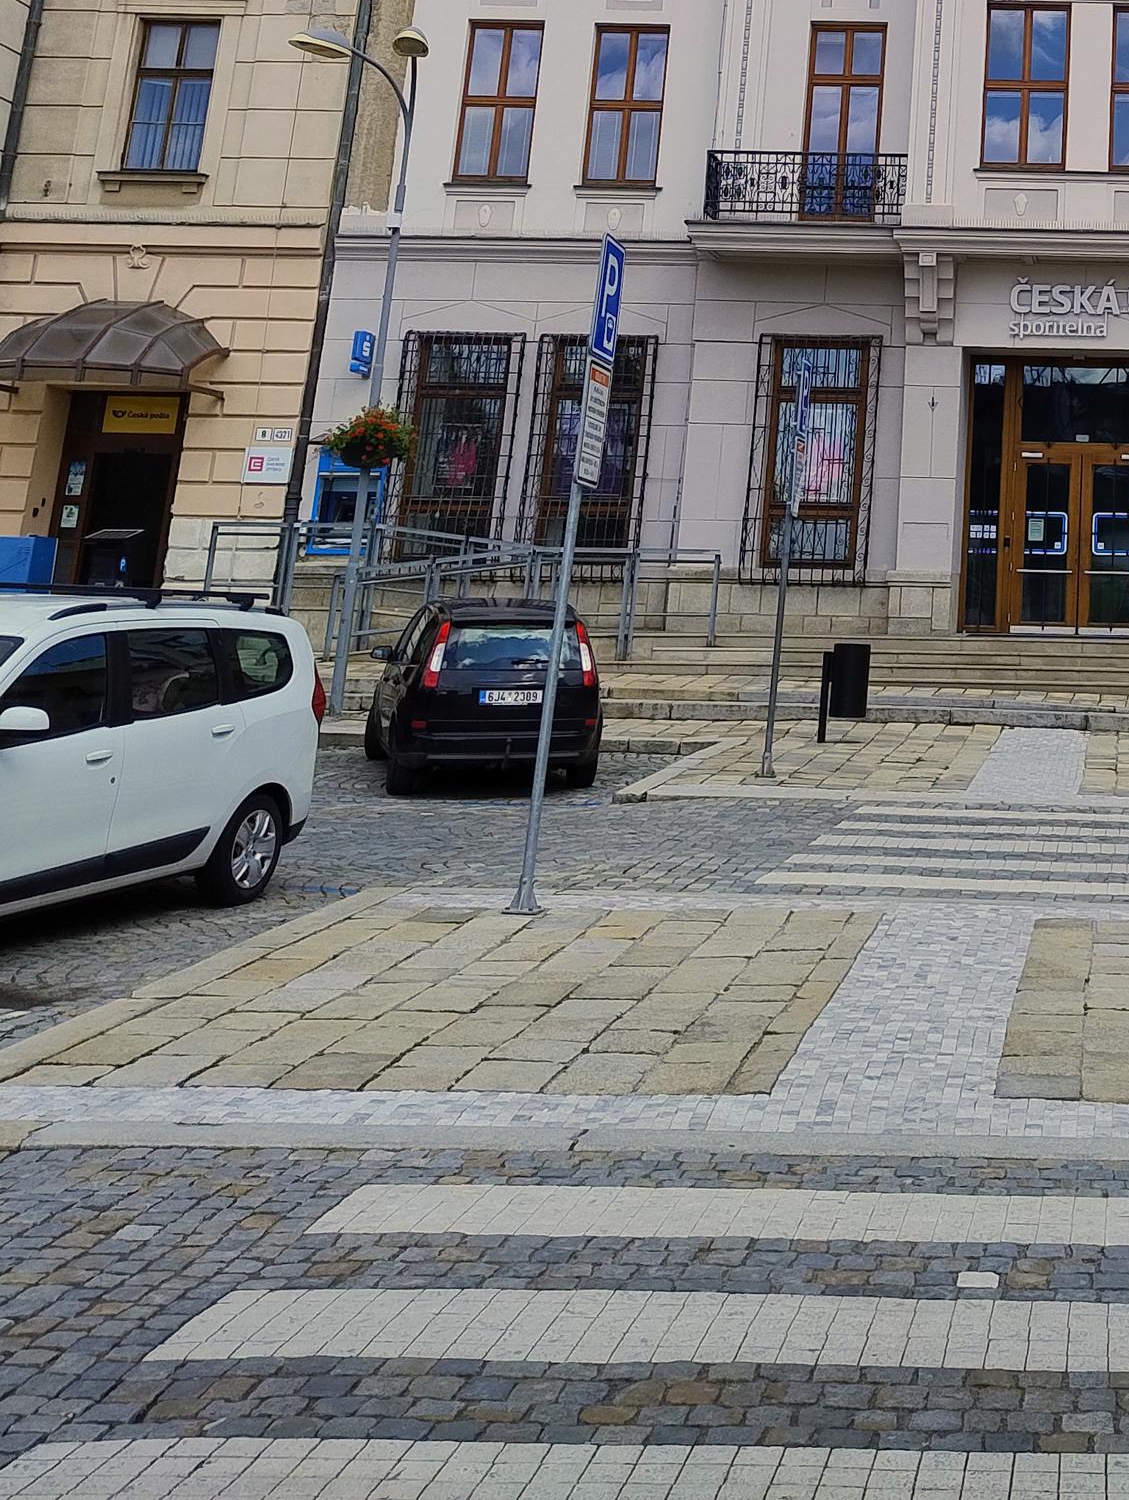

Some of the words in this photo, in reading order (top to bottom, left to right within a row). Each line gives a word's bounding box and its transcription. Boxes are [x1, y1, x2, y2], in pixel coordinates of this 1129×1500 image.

[601, 252, 619, 318] P
[1009, 276, 1121, 316] ČESKÁ
[127, 410, 148, 419] Česká
[149, 411, 170, 420] pošta
[488, 691, 506, 702] 6J4
